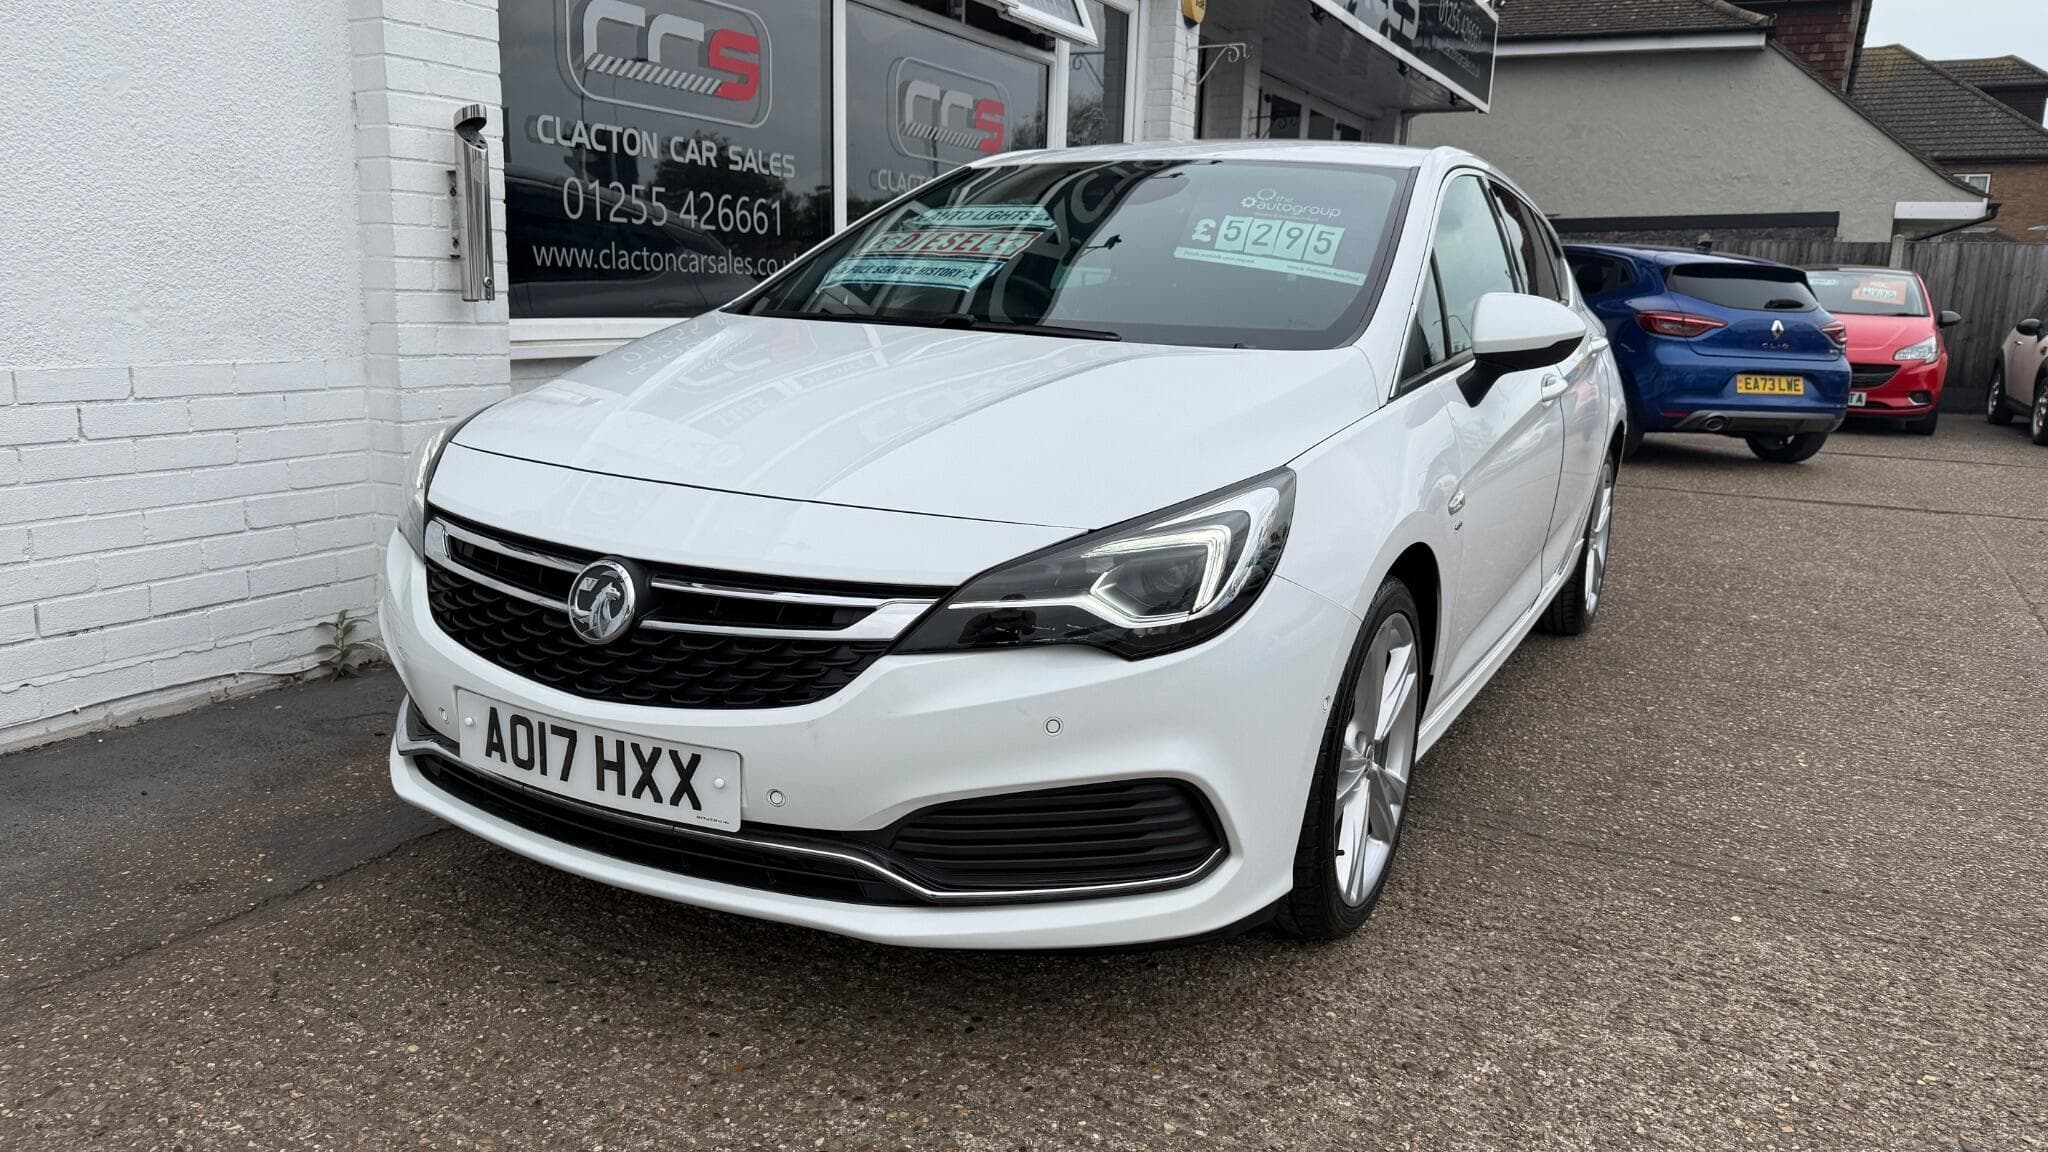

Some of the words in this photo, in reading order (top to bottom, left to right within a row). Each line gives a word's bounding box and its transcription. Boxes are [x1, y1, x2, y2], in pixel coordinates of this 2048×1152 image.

[536, 115, 658, 159] CLACTON
[670, 136, 717, 168] CAR
[728, 146, 796, 179] SALES
[563, 177, 668, 227] 01255
[679, 190, 782, 236] 426661
[972, 208, 1035, 221] LIGHTS
[1256, 200, 1341, 218] autogroup
[893, 232, 988, 252] DIESEL
[872, 265, 917, 275] SERVICE
[915, 266, 964, 278] HISTORY
[1761, 342, 1790, 350] CLIO
[1744, 377, 1776, 391] EA73
[1778, 378, 1801, 392] LWE
[485, 706, 578, 782] AO17
[594, 734, 703, 812] HXX
